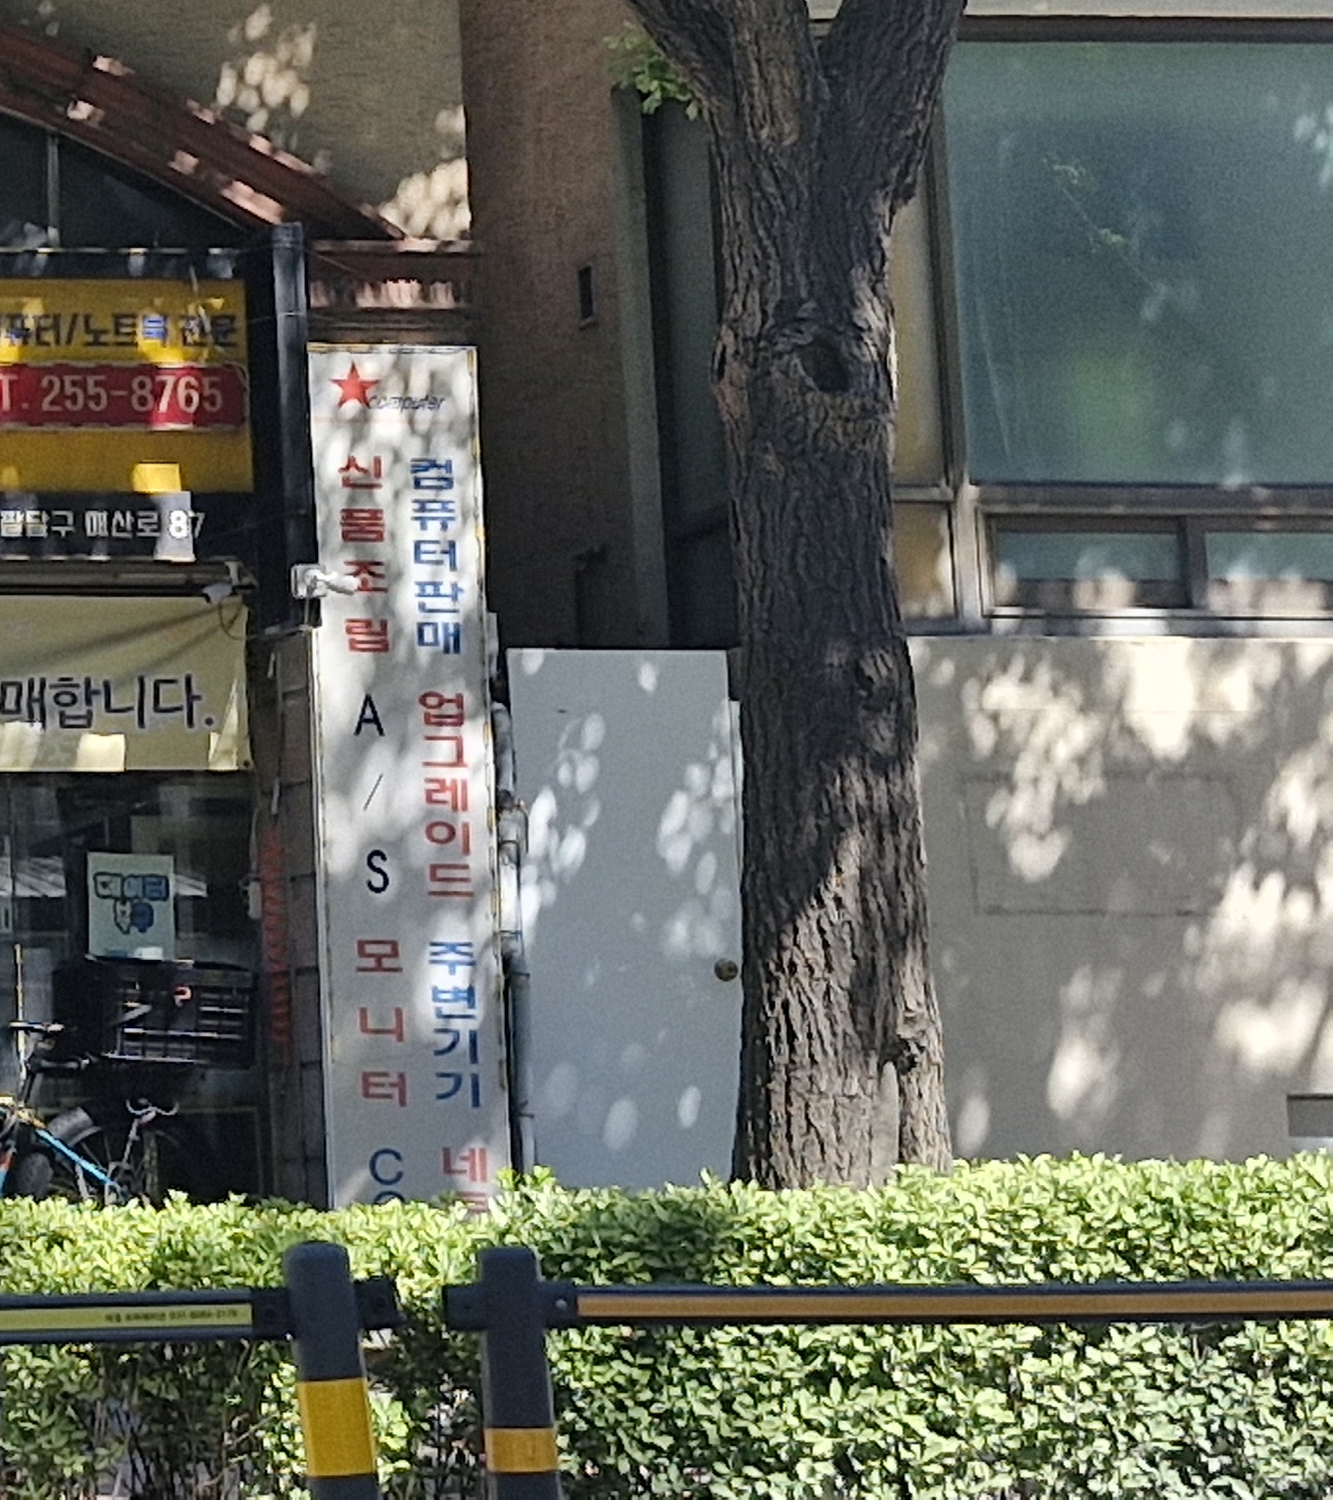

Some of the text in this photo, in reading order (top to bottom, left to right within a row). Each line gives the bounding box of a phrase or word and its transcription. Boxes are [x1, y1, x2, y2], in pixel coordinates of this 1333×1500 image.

[40, 373, 223, 414] 255-8765
[182, 313, 237, 347] 전문
[367, 392, 446, 411] computer
[0, 510, 76, 538] 팔달구
[85, 510, 161, 538] 매산로
[168, 510, 206, 539] 87
[337, 455, 393, 654] 신품조립
[409, 457, 466, 655] 컴퓨터판매
[418, 689, 475, 900] 업그레이드
[355, 938, 409, 1108] 모니터
[428, 941, 482, 1109] 주변기기
